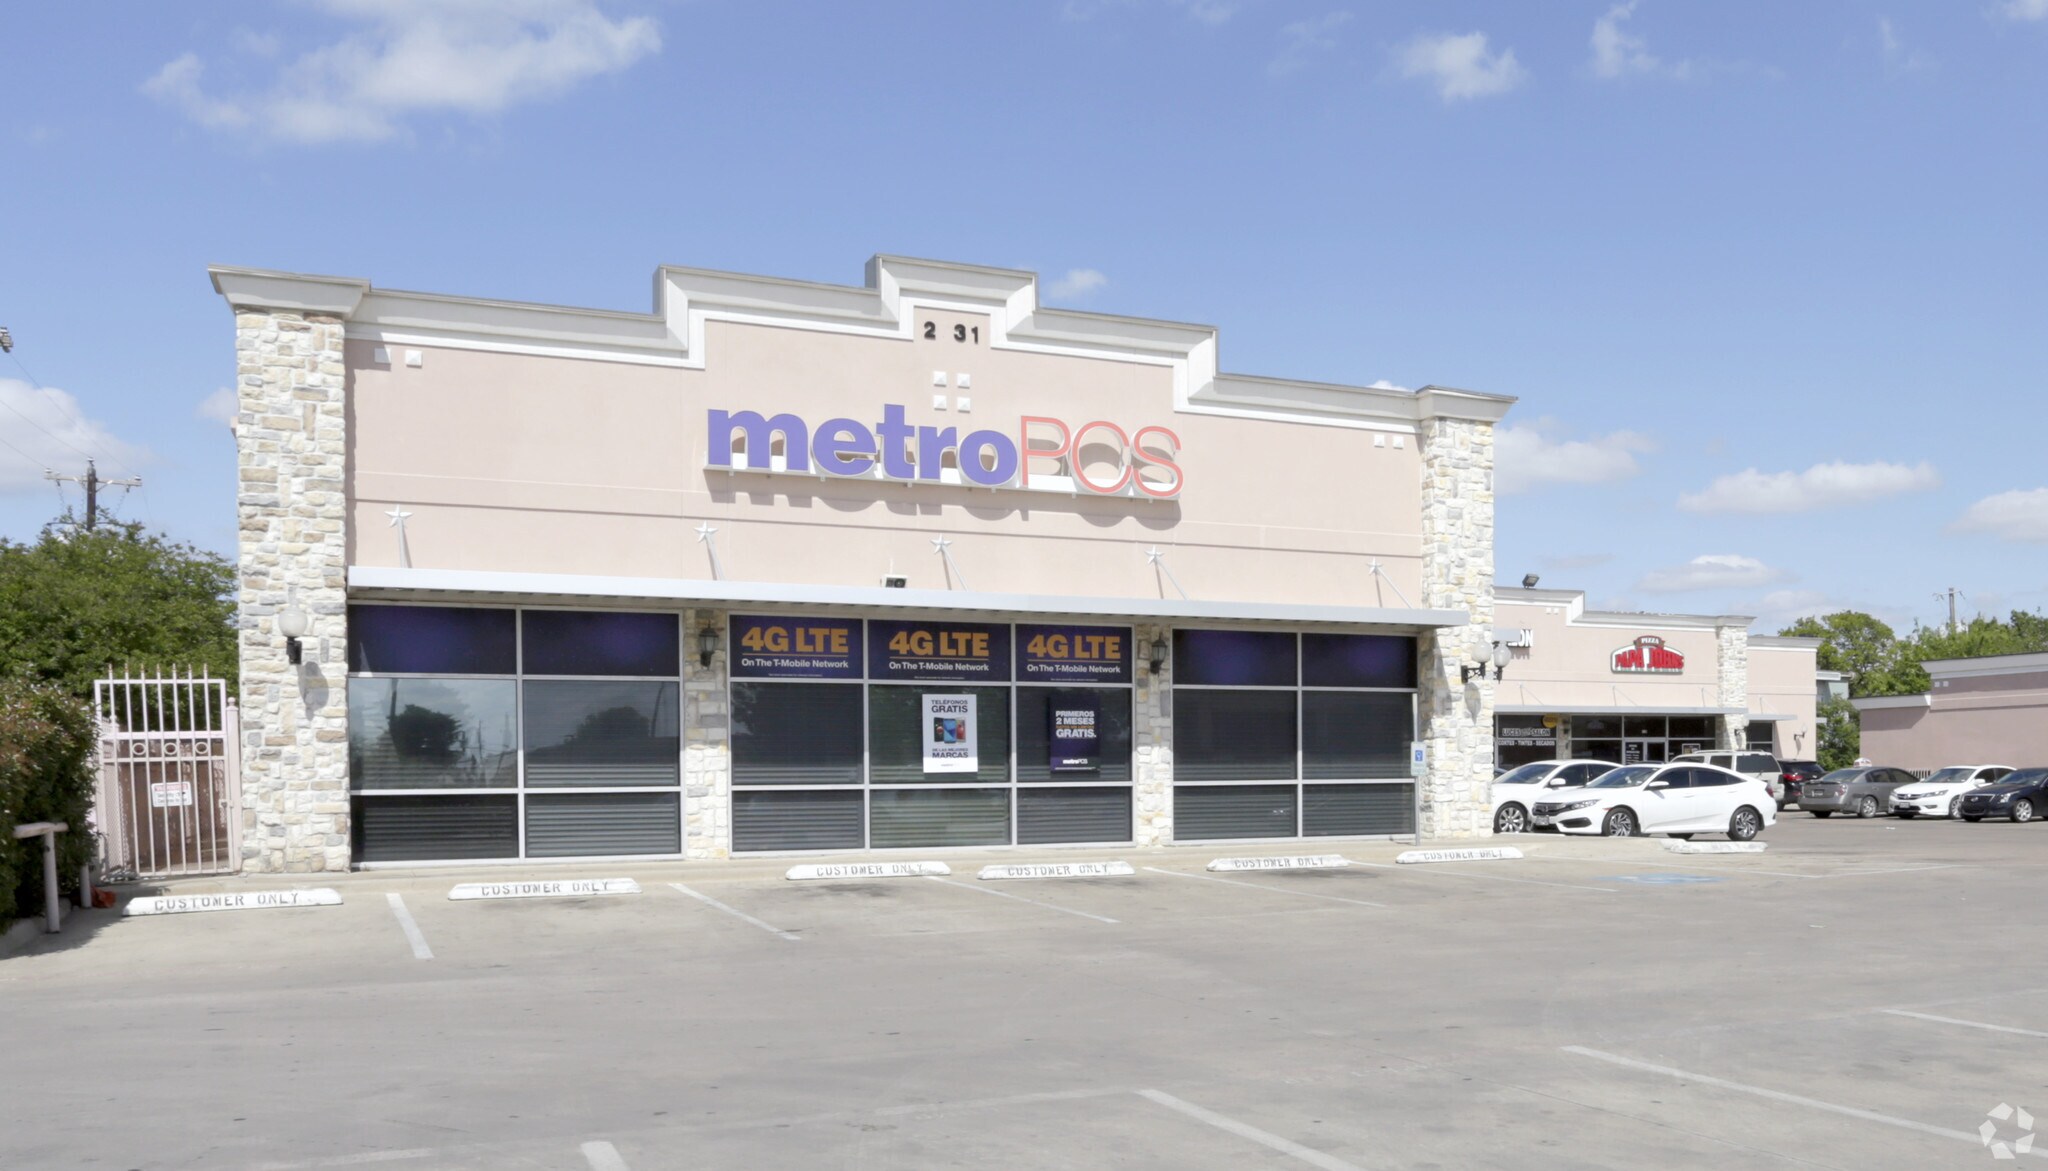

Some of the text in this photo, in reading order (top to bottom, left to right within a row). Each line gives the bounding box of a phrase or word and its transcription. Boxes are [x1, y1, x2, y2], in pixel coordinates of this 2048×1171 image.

[707, 403, 1184, 498] metroPCS
[741, 626, 849, 653] 4G LTE
[889, 630, 989, 656] 4G LTE
[1027, 634, 1120, 659] 4G LTE
[741, 658, 849, 668] On The T-Mobile Network
[1615, 648, 1644, 668] PAPA
[902, 662, 918, 670] The
[918, 662, 953, 670] T-Mobile
[955, 663, 989, 671] Network
[1027, 664, 1120, 673] On The T-Mobile Network
[931, 705, 968, 713] GRATIS
[1056, 717, 1095, 725] 2 MESES
[1056, 728, 1097, 738] GRATIS.
[1234, 857, 1324, 868] CUSTOMER ONLY
[817, 863, 924, 877] CUSTOMER ONLY
[1007, 864, 1109, 876] CUSTOMER ONLY
[481, 881, 609, 896] CUSTOMER ONLY
[154, 892, 298, 911] CUSTOMER ONLY
